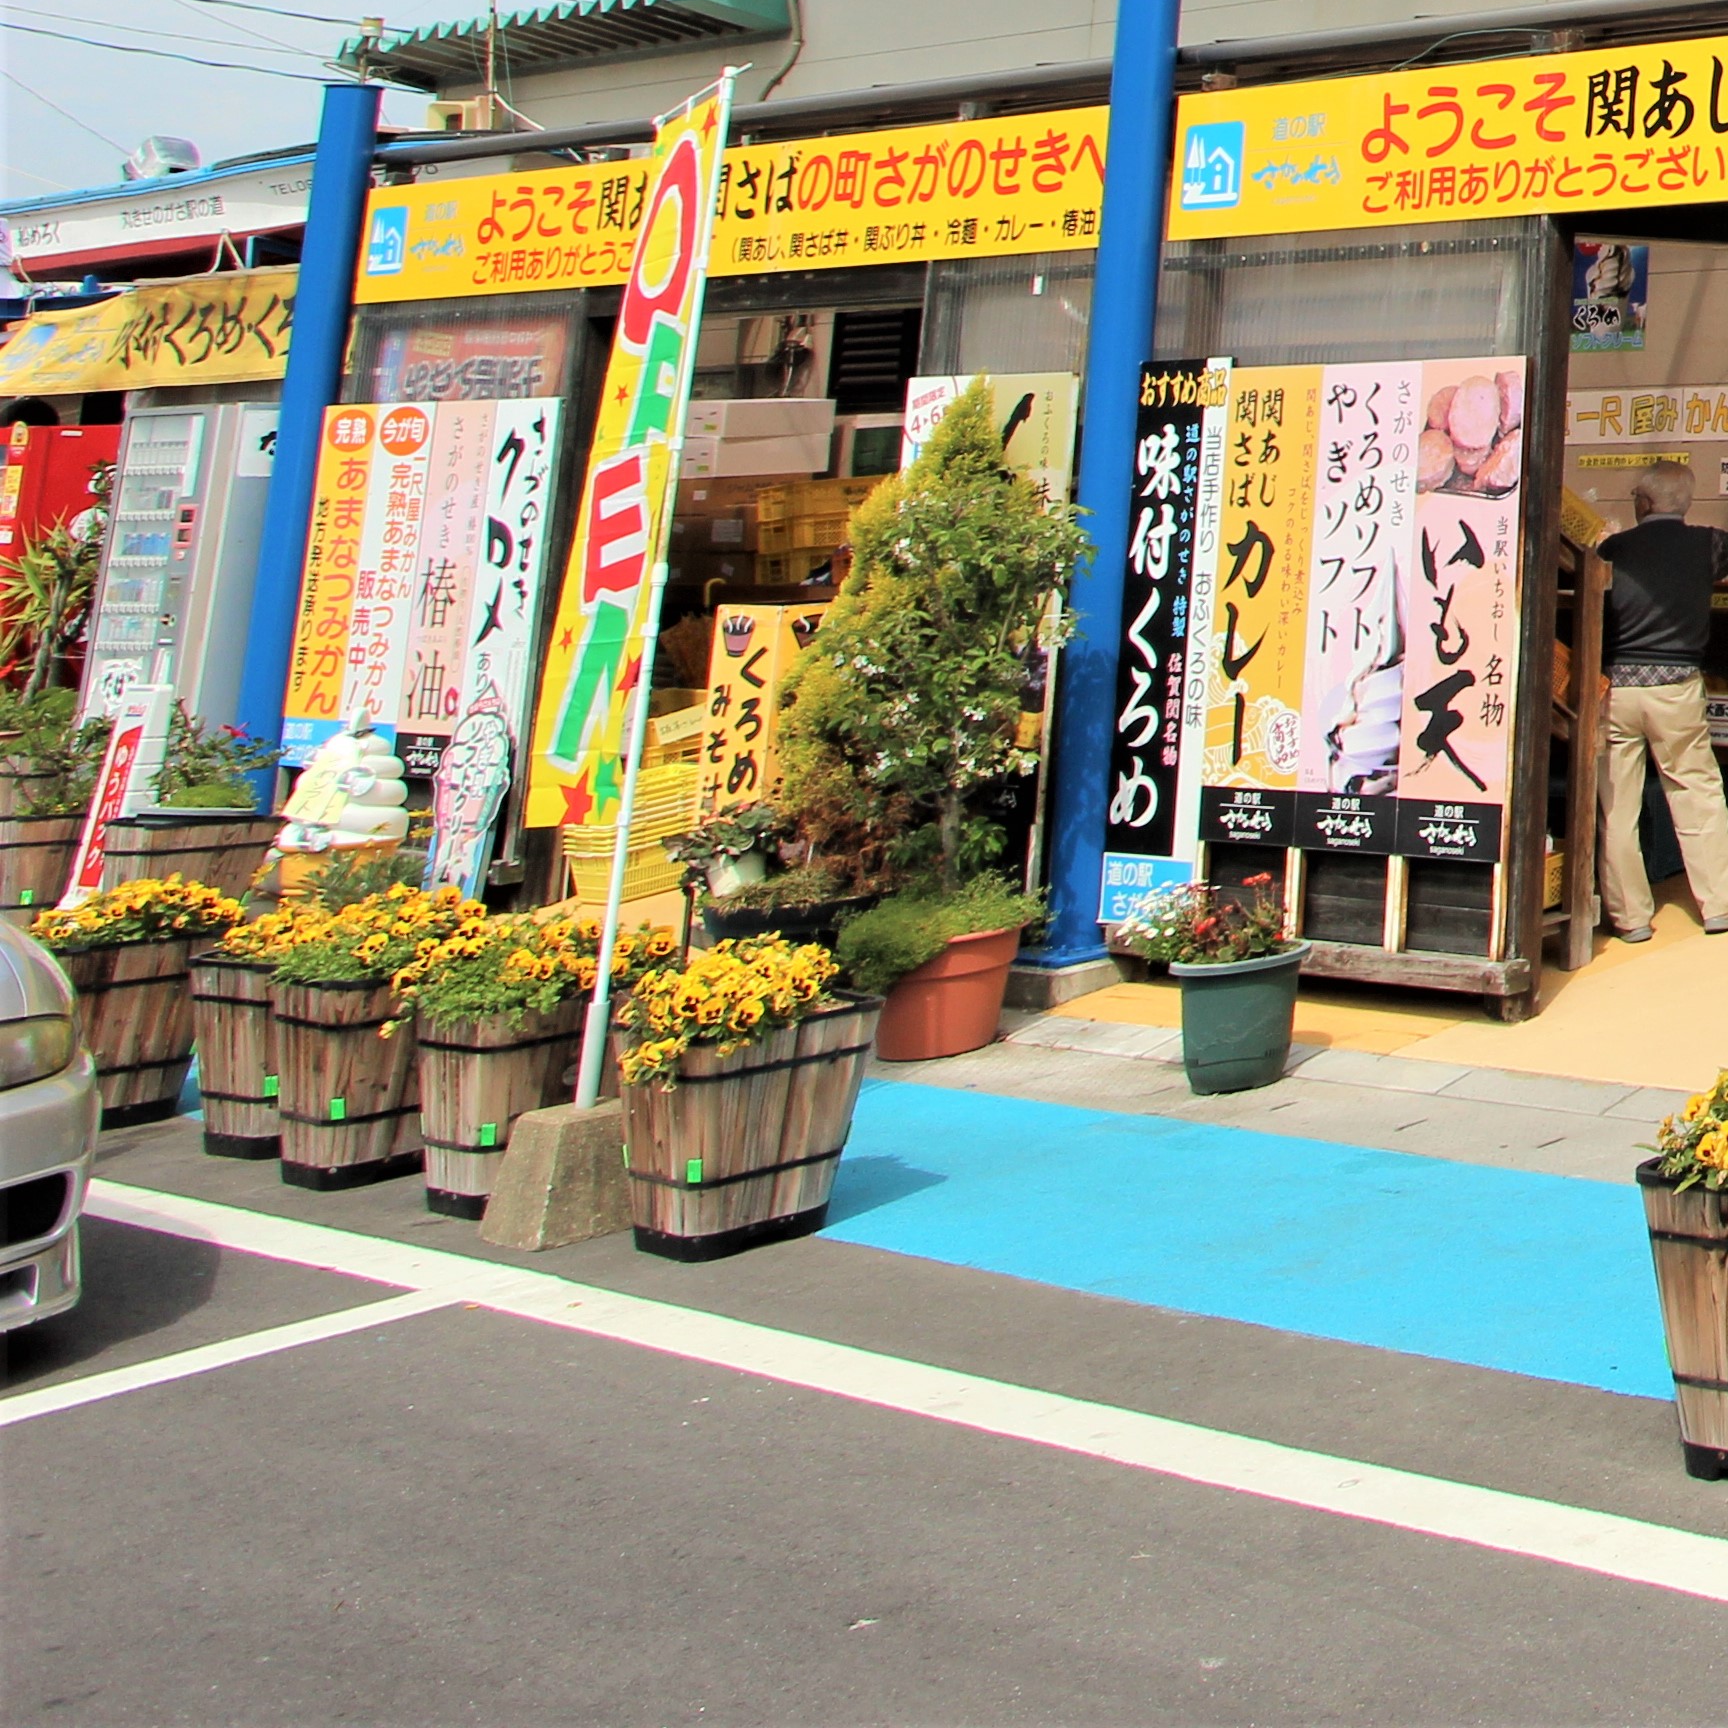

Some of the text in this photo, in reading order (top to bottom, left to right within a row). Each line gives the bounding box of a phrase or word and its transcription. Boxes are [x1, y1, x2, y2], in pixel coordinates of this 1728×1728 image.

[1272, 112, 1325, 141] 道の駅
[1140, 366, 1228, 408] おすすめ商品
[1571, 330, 1644, 350] ソフトクリーム
[1573, 305, 1621, 330] くろめ
[334, 417, 367, 445] 完熟
[383, 417, 426, 443] 今が旬
[440, 416, 465, 550] さがのせき
[549, 132, 702, 775] OPEN
[1228, 389, 1259, 509] 関さば
[1258, 387, 1285, 508] 関あじ
[1292, 387, 1318, 615] 関あじ、関さばをじっくり煮込み
[1389, 379, 1414, 528] さがのせき
[304, 457, 368, 715] あまなつみかん
[396, 456, 427, 599] 一尺屋みかん
[1171, 423, 1201, 638] 道の駅さがのせき 特製
[1185, 425, 1223, 728] 当店手作り おふくろの味
[1275, 487, 1297, 689] コクのある味わい深いカレー
[1318, 383, 1357, 655] やぎソフト
[1351, 382, 1384, 652] くろめソフト
[345, 570, 377, 711] 販売中!
[364, 463, 413, 716] 完熟あまなつみかん
[406, 557, 457, 720] 椿油
[1109, 423, 1183, 828] 味付くろめ
[1219, 520, 1276, 767] カレー
[1404, 519, 1489, 793] いも天
[1480, 516, 1510, 729] 当駅いちおし 名物
[702, 684, 732, 798] みそ汁
[727, 646, 769, 795] くろめ
[1161, 652, 1184, 767] 佐賀関名物
[1234, 791, 1261, 805] 道の駅
[1332, 797, 1360, 811] 道の駅
[1435, 804, 1464, 818] 道の駅
[1107, 860, 1153, 887] 道の駅
